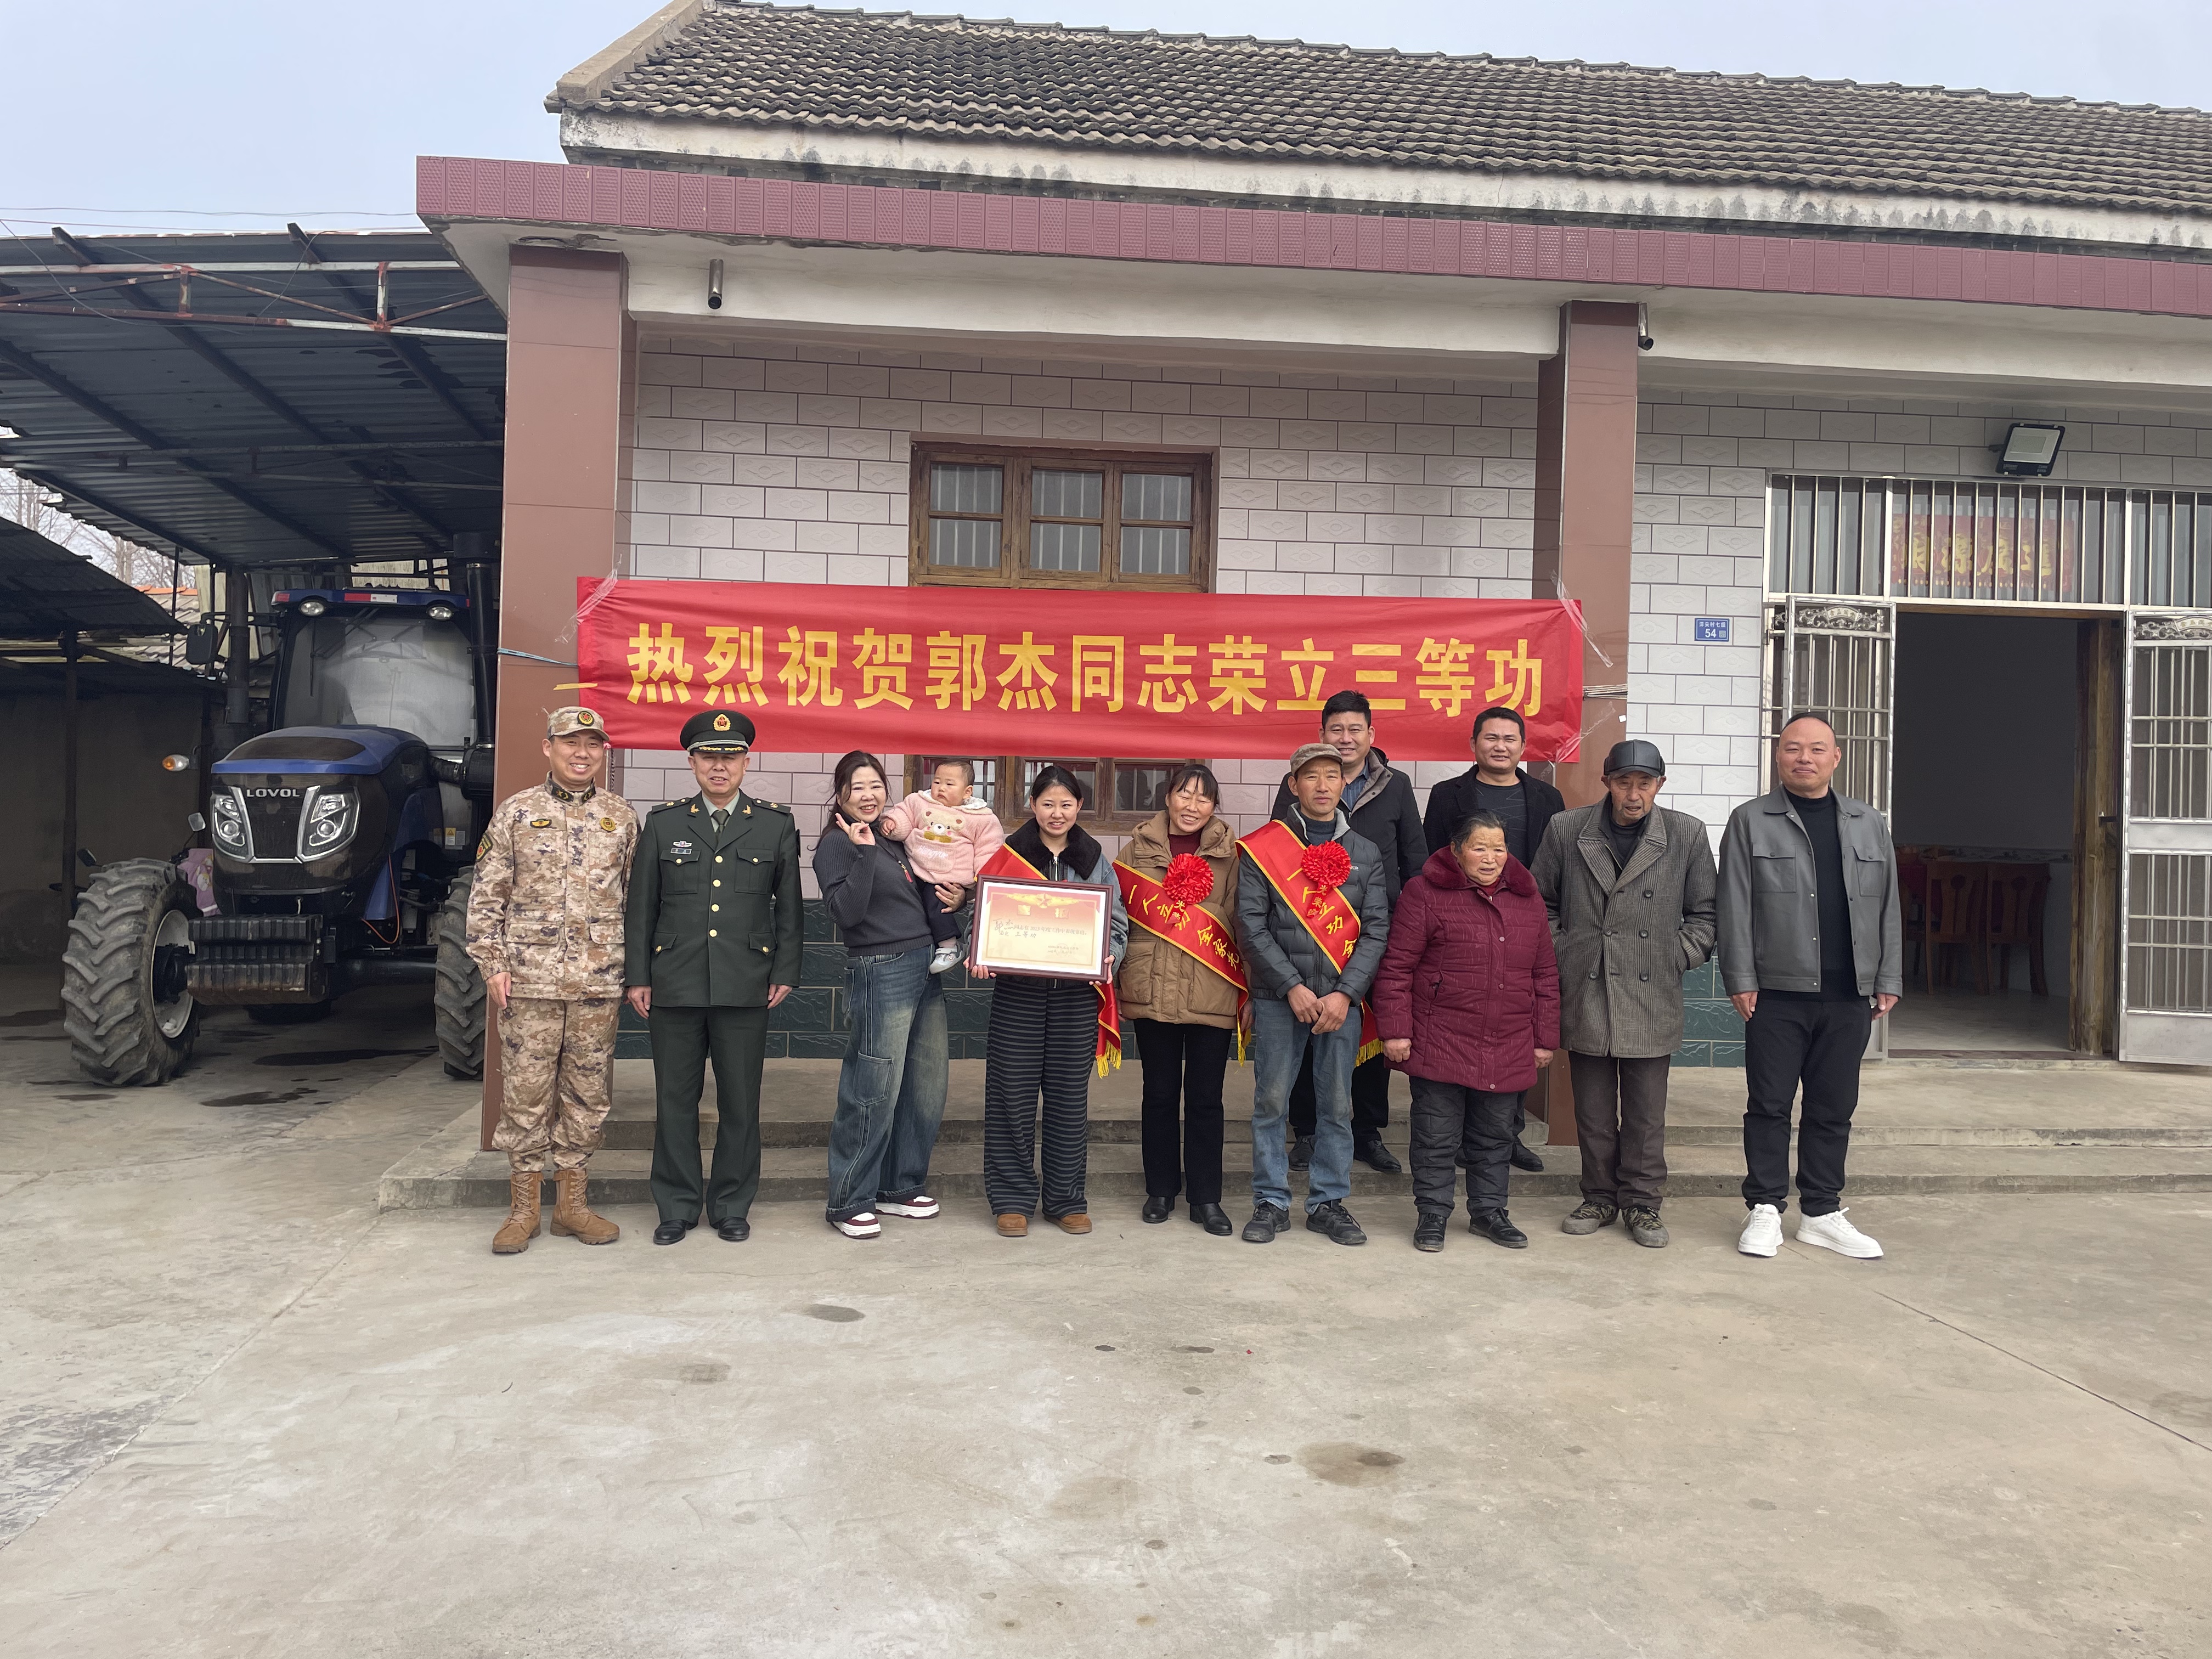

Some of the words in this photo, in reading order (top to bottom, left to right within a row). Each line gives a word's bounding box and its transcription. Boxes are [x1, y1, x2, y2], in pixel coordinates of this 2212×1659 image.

[1705, 628, 1717, 638] 54
[626, 622, 1543, 718] 热烈祝贺郭杰同志荣立三等功
[246, 788, 300, 797] LOVOL
